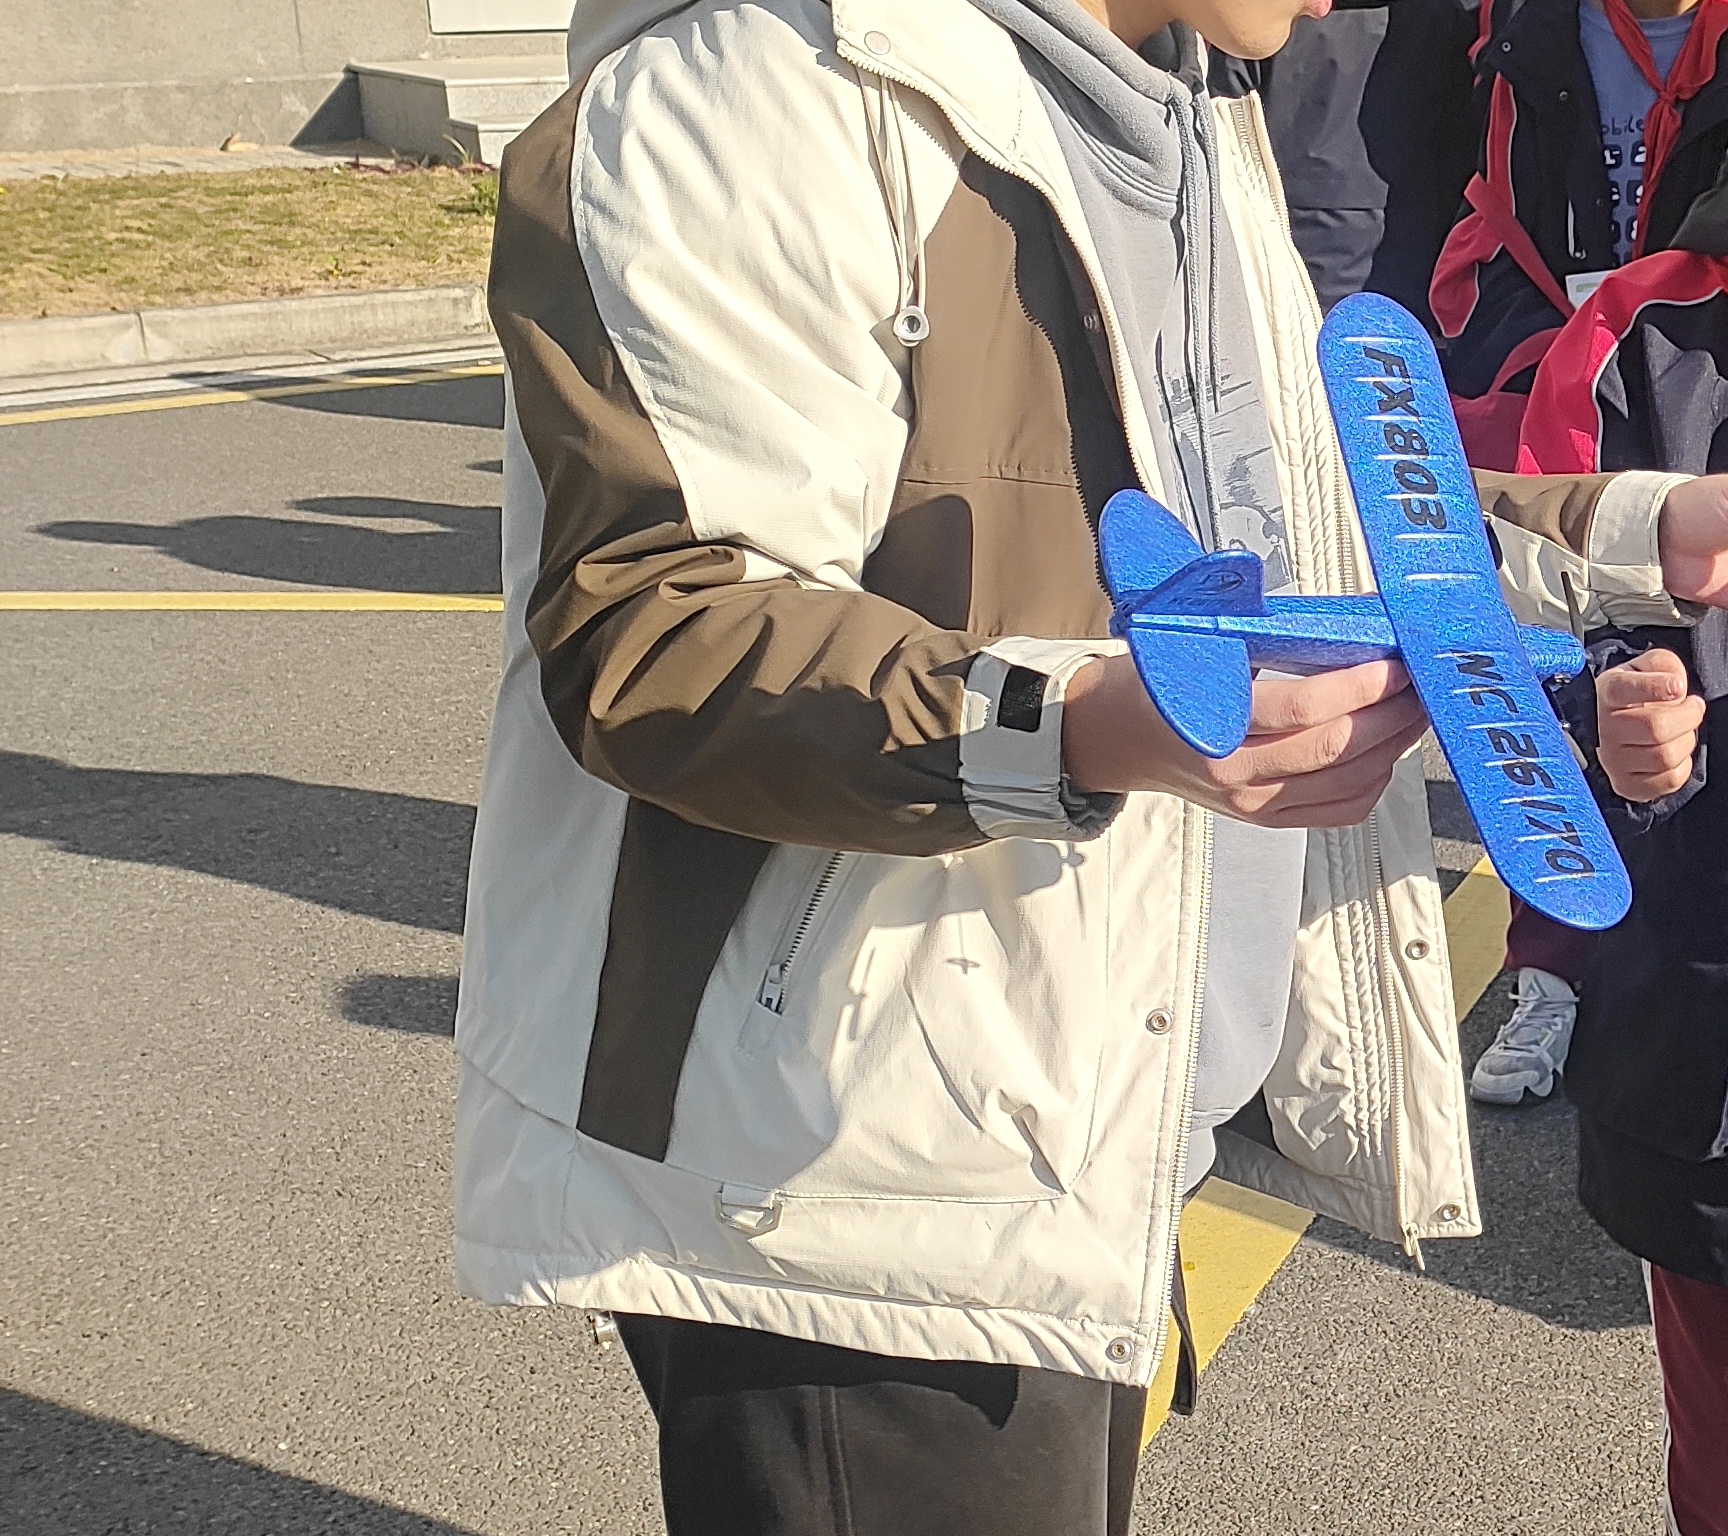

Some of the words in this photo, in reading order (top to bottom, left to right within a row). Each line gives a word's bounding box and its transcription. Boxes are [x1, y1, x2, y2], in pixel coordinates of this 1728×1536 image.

[1601, 115, 1644, 136] obile
[1363, 345, 1448, 530] FX803
[1449, 648, 1520, 715] NC
[1485, 728, 1597, 876] 26170
